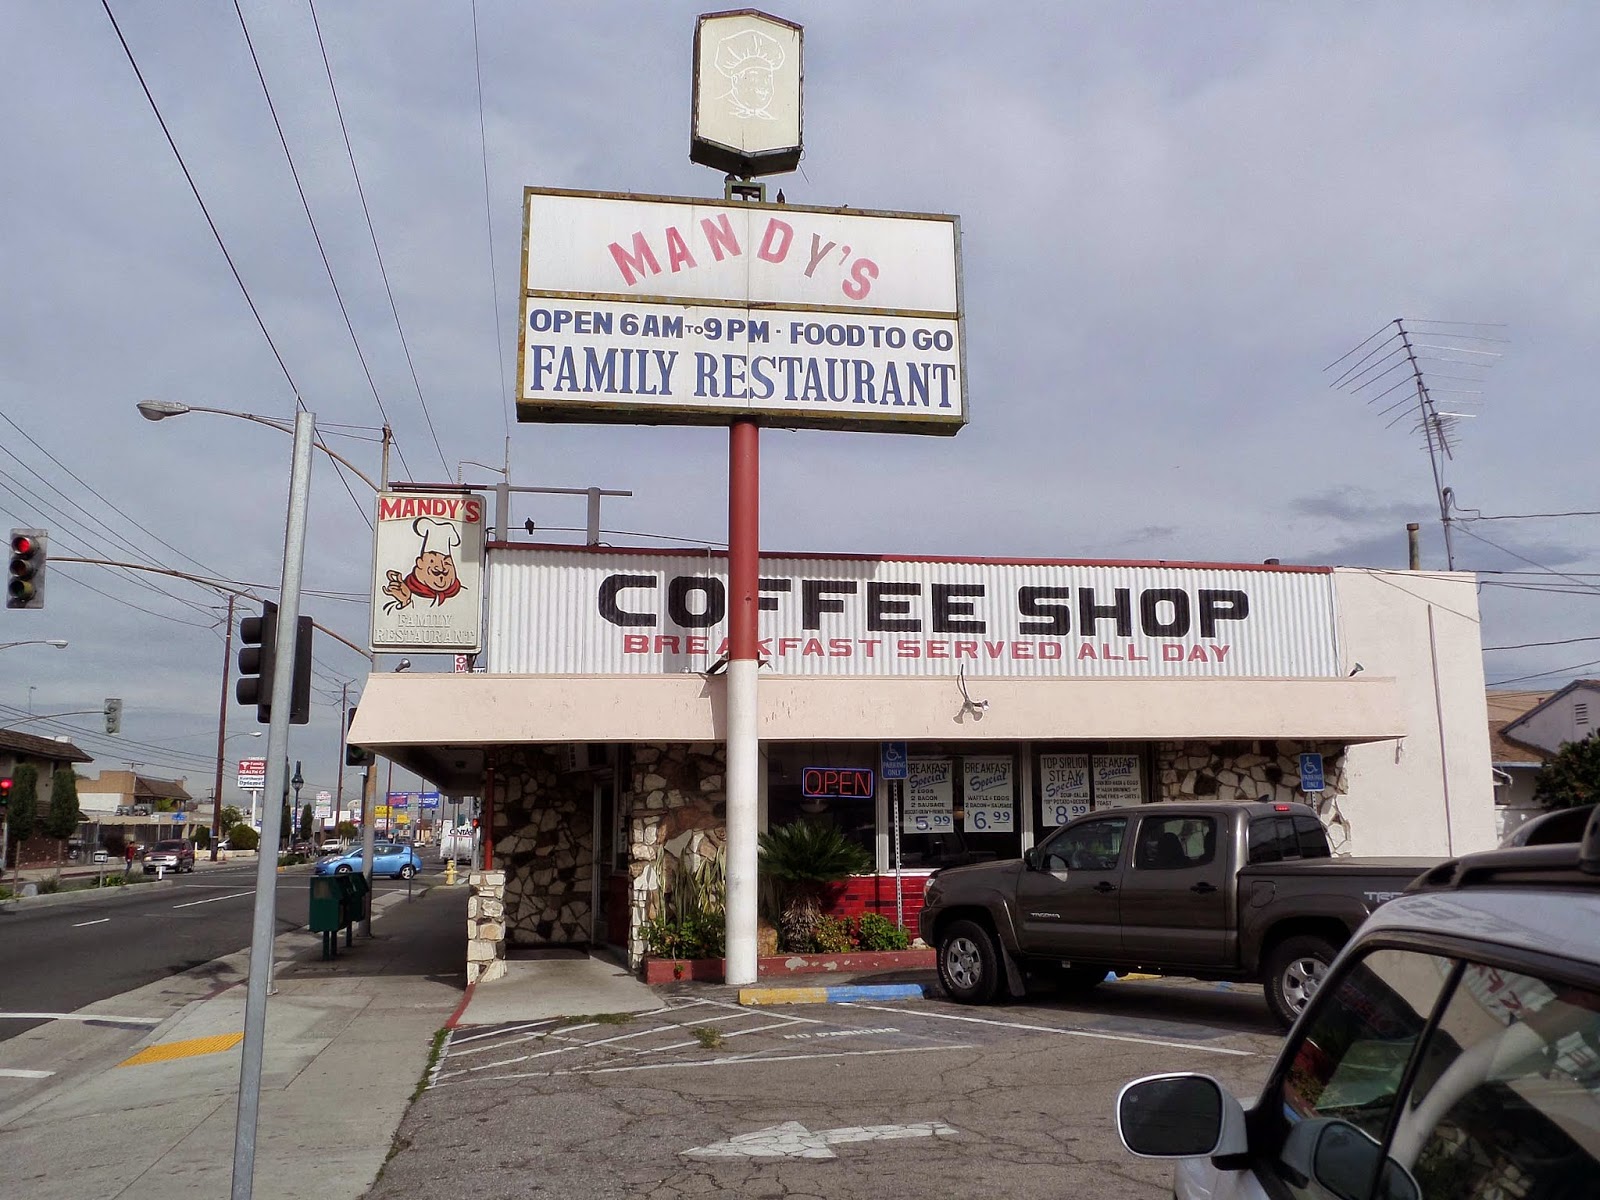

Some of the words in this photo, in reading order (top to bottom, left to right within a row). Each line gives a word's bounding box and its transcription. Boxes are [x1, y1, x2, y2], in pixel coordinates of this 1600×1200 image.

[608, 213, 880, 301] MANDY'S
[529, 308, 613, 335] OPEN
[685, 324, 704, 336] TO
[790, 321, 865, 347] FOOD
[866, 325, 907, 349] TO
[912, 327, 954, 352] GO
[530, 344, 679, 397] FAMILY
[694, 351, 956, 408] RESTAURANT
[379, 497, 480, 523] MANDY'S
[598, 573, 986, 634] COFFEE
[1017, 584, 1249, 639] SHOP
[398, 614, 451, 628] FAMILY
[374, 629, 475, 644] RESTAURANT
[623, 634, 882, 658] BREAKFAST
[896, 639, 1062, 660] SERVED
[1077, 642, 1149, 662] ALL
[1162, 643, 1231, 663] DAY
[883, 761, 906, 769] PARKING
[964, 763, 1011, 774] BREAKFAST
[1042, 757, 1057, 769] TOP
[1093, 757, 1138, 768] BREAKFAST
[1099, 760, 1132, 780] Special
[804, 770, 871, 796] OPEN
[909, 767, 946, 789] Special
[970, 767, 1007, 792] Special
[1045, 771, 1084, 798] Special
[1049, 769, 1081, 782] STEAK
[815, 1027, 900, 1038] PARKING
